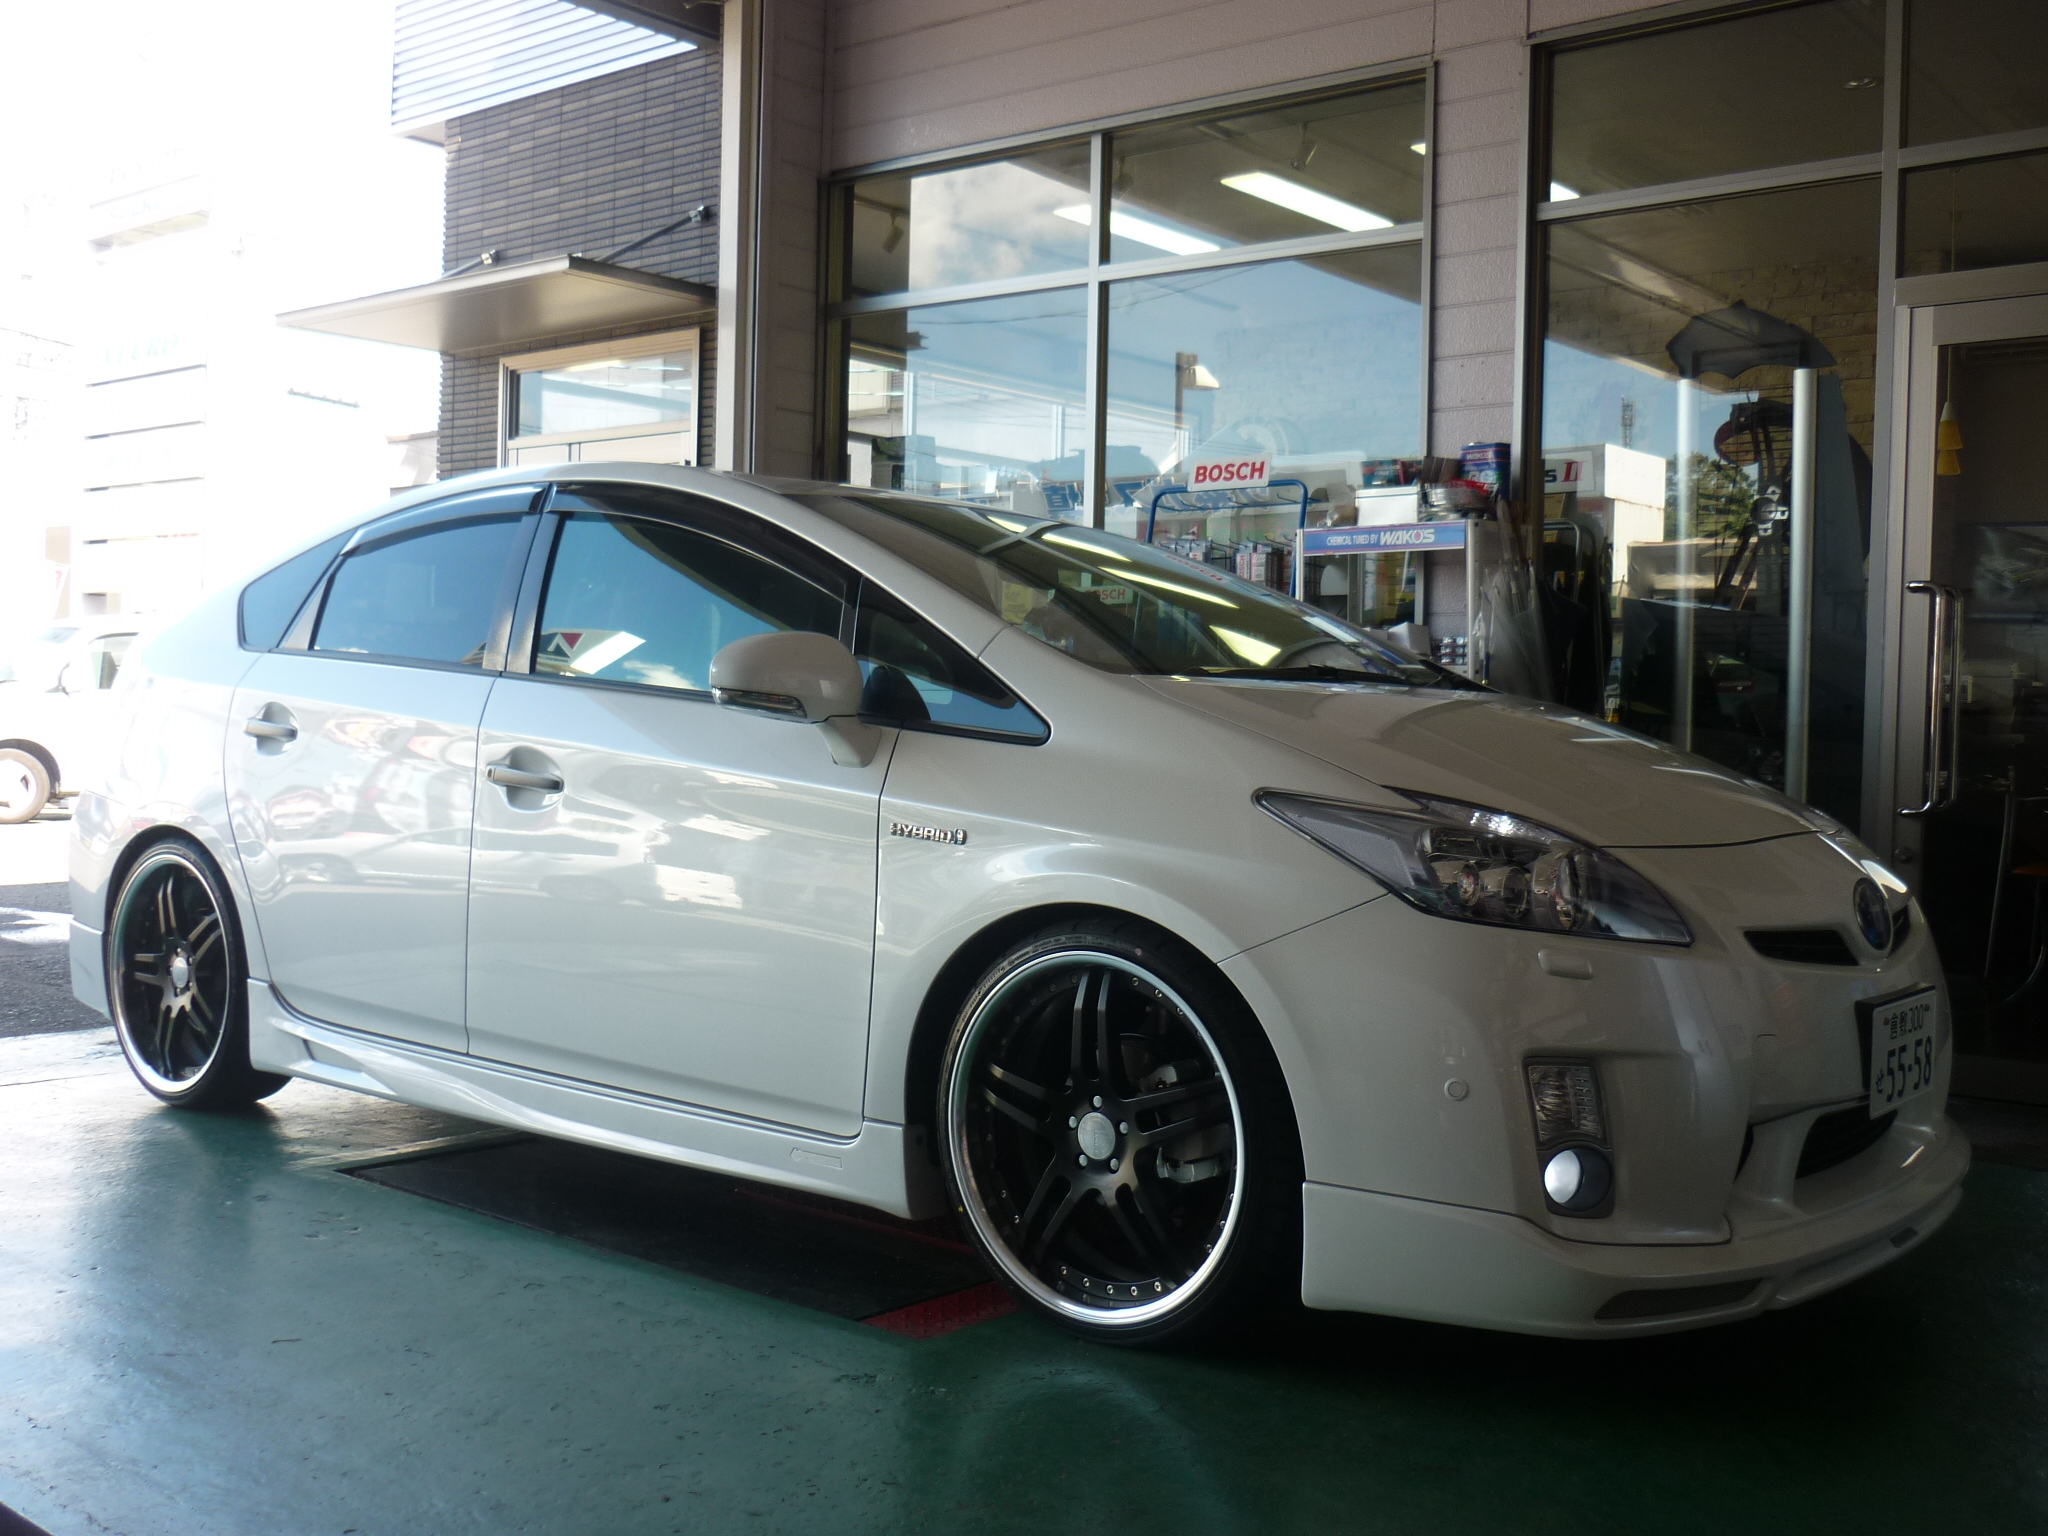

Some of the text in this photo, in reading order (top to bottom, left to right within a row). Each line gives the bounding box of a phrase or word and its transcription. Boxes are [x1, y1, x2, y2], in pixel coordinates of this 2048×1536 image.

[1194, 461, 1265, 484] BOSCH
[1326, 536, 1352, 546] CHEMICAL
[1353, 535, 1370, 545] TUNED
[1370, 534, 1379, 544] BY
[1886, 1035, 1933, 1102] 55-58
